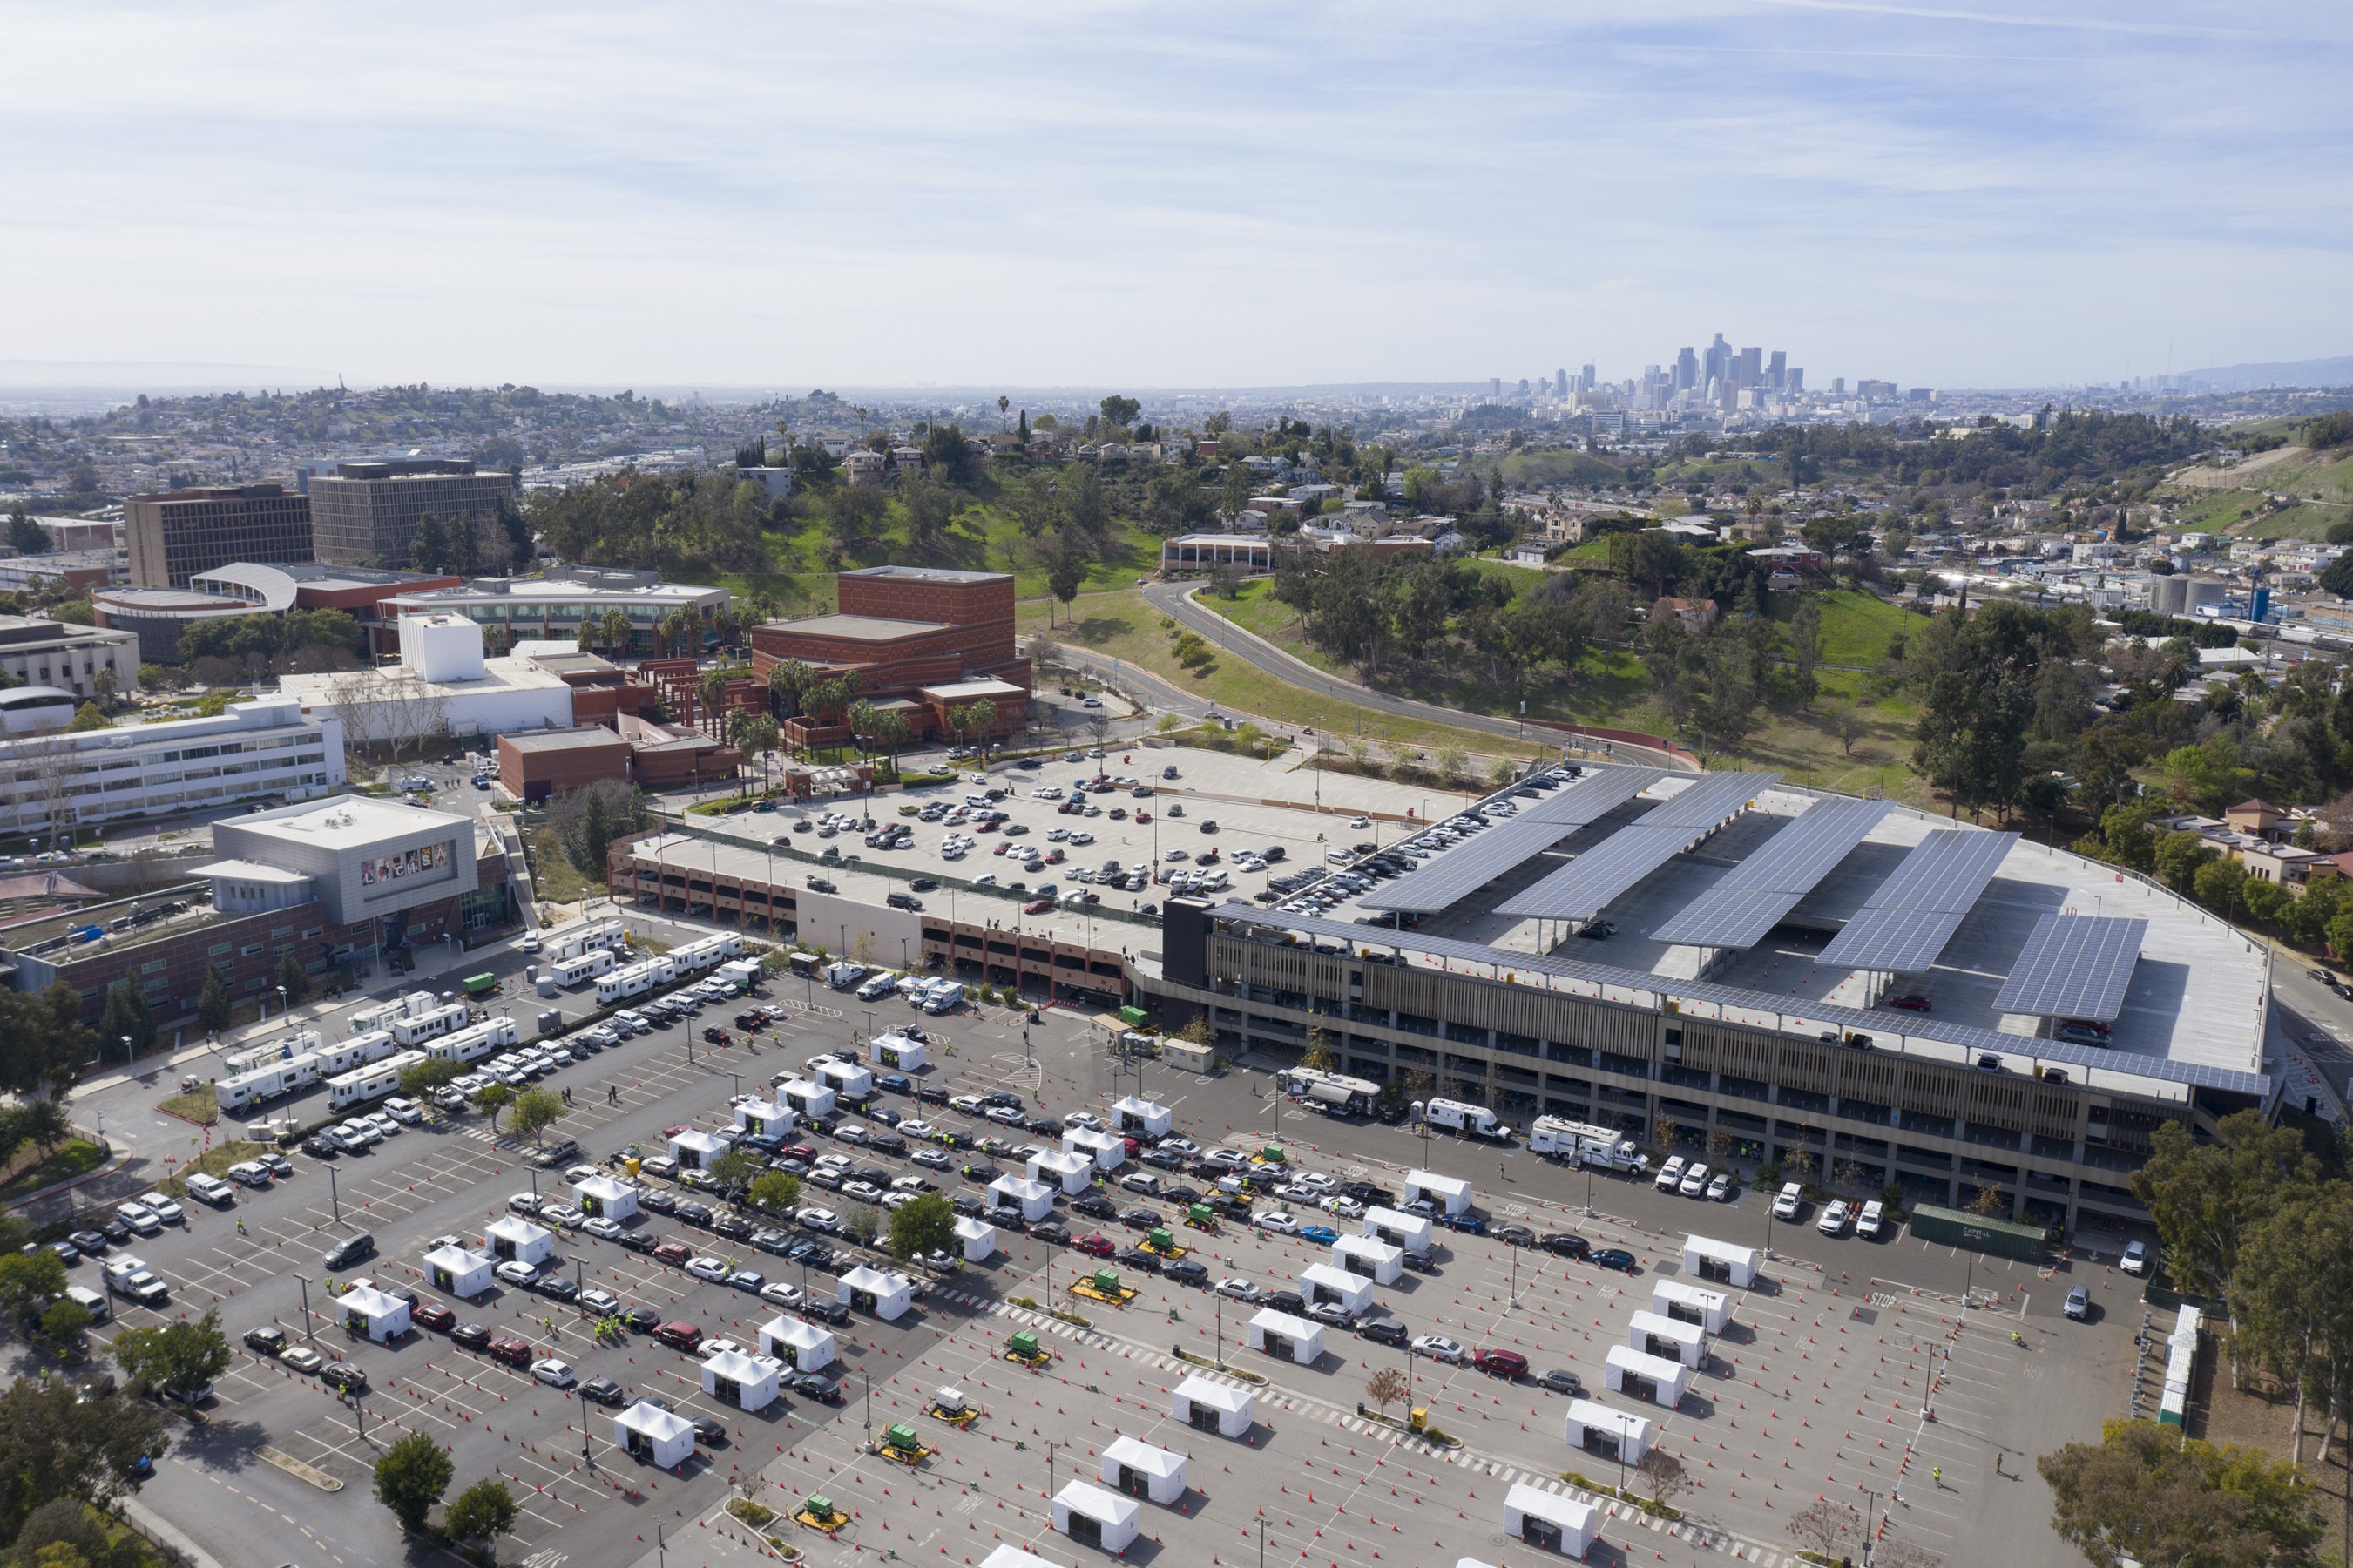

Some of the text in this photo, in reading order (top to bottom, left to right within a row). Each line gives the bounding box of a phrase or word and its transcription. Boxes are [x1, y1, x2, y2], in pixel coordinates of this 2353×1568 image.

[1342, 1165, 1369, 1179] STOP
[1502, 1203, 1527, 1218] STOP
[1963, 1227, 1991, 1238] CAPITAL
[2091, 1220, 2114, 1233] STOP
[1869, 1292, 1897, 1308] STOP
